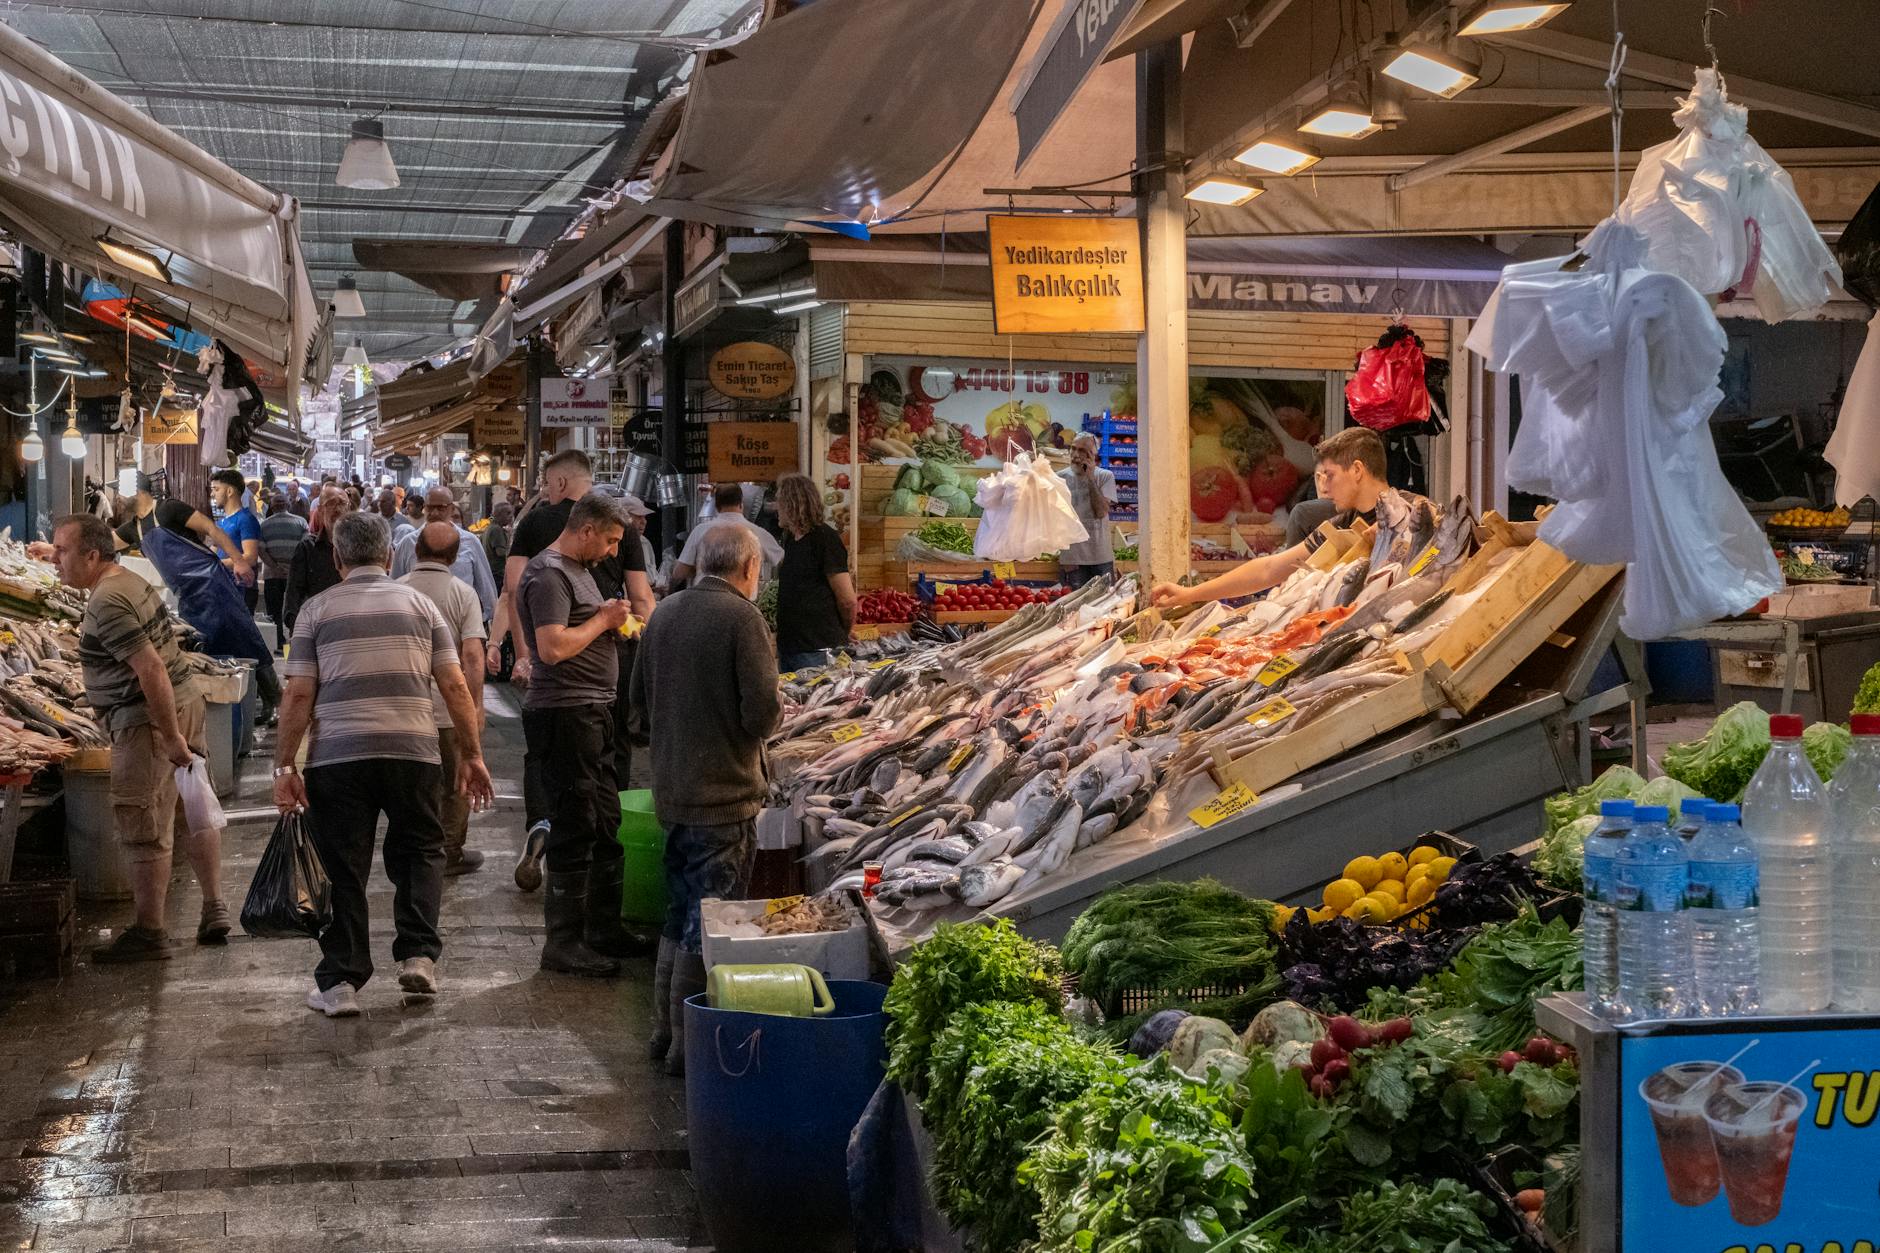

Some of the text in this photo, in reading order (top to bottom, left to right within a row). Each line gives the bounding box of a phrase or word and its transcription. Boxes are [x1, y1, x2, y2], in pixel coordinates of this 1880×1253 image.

[1005, 246, 1127, 269] Yedikardeşler
[1016, 274, 1122, 304] Balıkçılık
[1186, 274, 1379, 303] Manav
[717, 361, 787, 371] Emin Ticaret
[1023, 370, 1049, 393] 15
[736, 435, 769, 453] Köşe
[731, 453, 775, 467] Manav
[1813, 1070, 1880, 1129] TU
